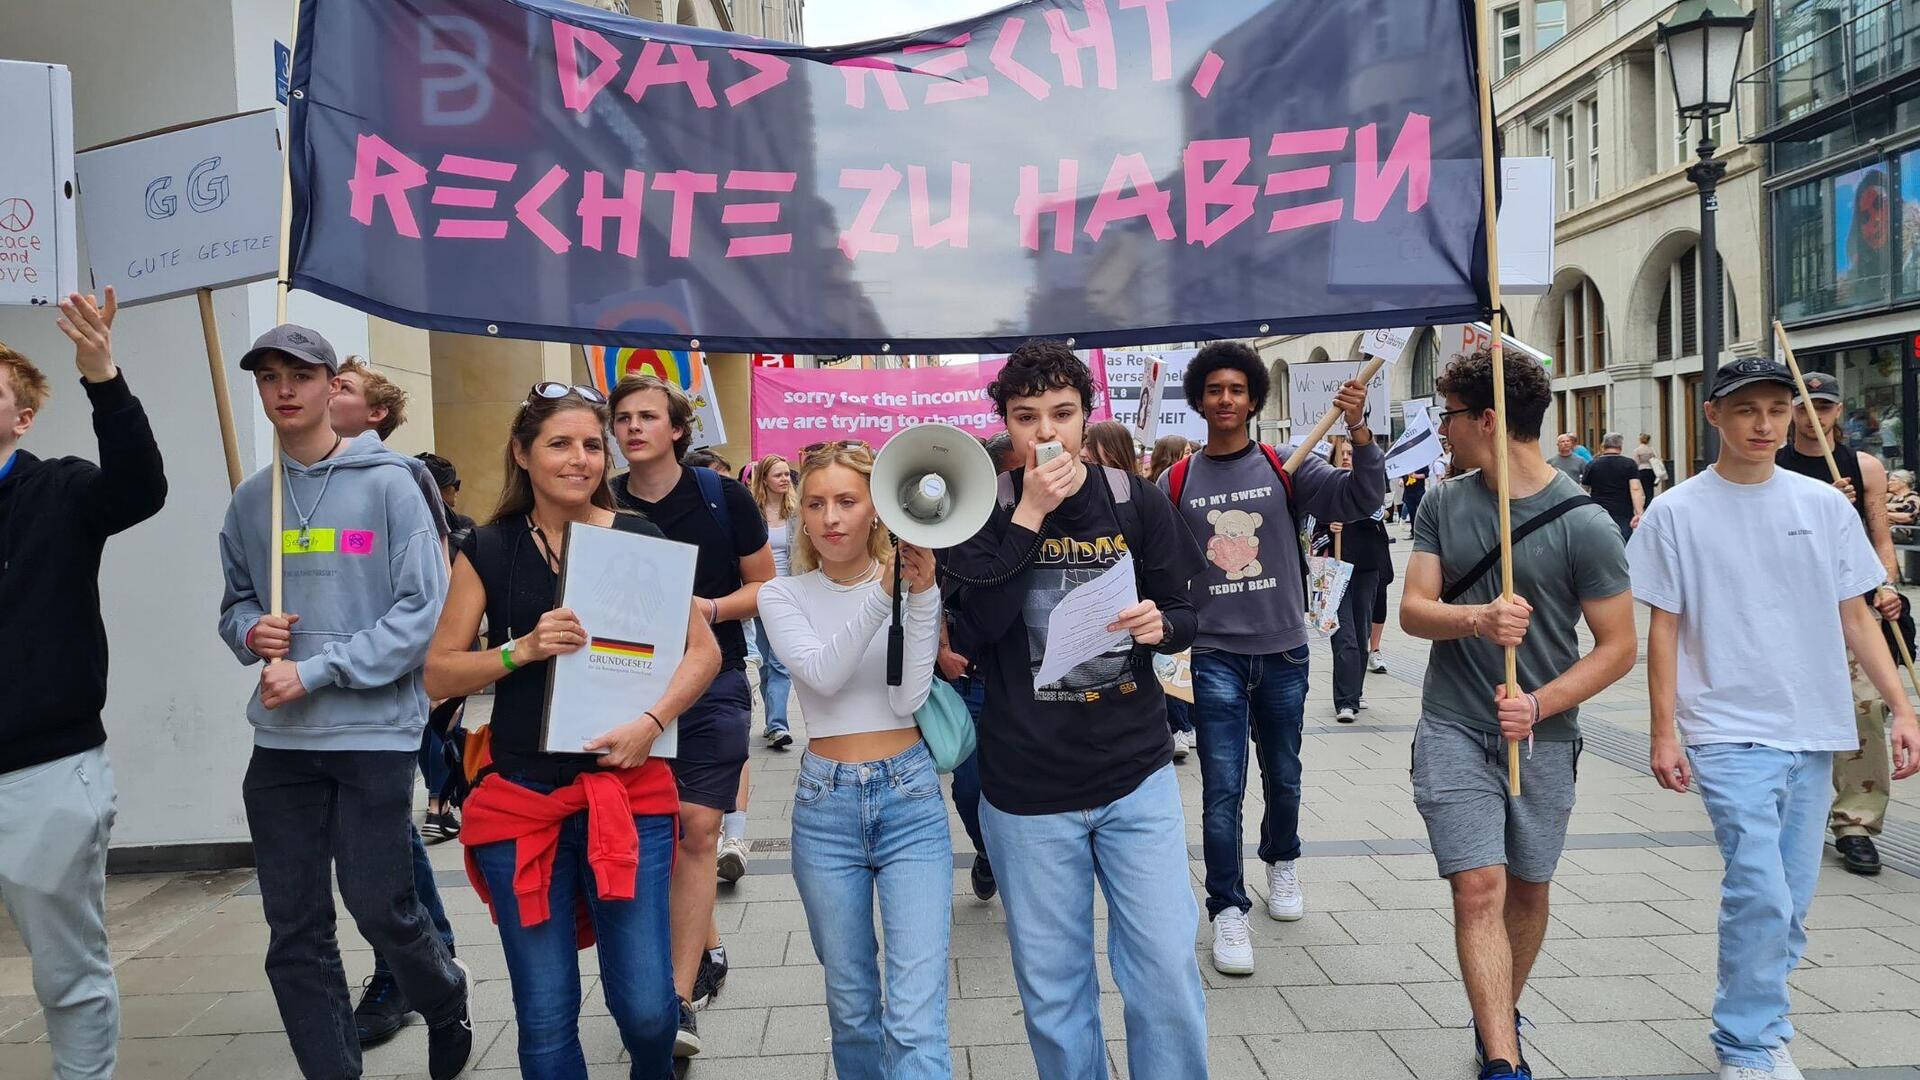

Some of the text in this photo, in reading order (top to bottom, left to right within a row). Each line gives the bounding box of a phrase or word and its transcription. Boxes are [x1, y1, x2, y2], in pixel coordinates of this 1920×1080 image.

[348, 112, 1431, 260] RECHTE ZU HABEN
[127, 235, 273, 278] GUTE GESETZE
[783, 391, 836, 408] sorry
[839, 391, 869, 404] for
[872, 392, 907, 406] the
[1120, 388, 1128, 398] 8
[756, 416, 790, 429] we
[793, 416, 828, 429] are
[830, 413, 893, 432] trying
[897, 413, 920, 427] to
[1190, 486, 1272, 509] TO MY SWEET
[1208, 577, 1277, 596] TEDDY BEAR
[589, 654, 653, 670] GRUNDGESETZ
